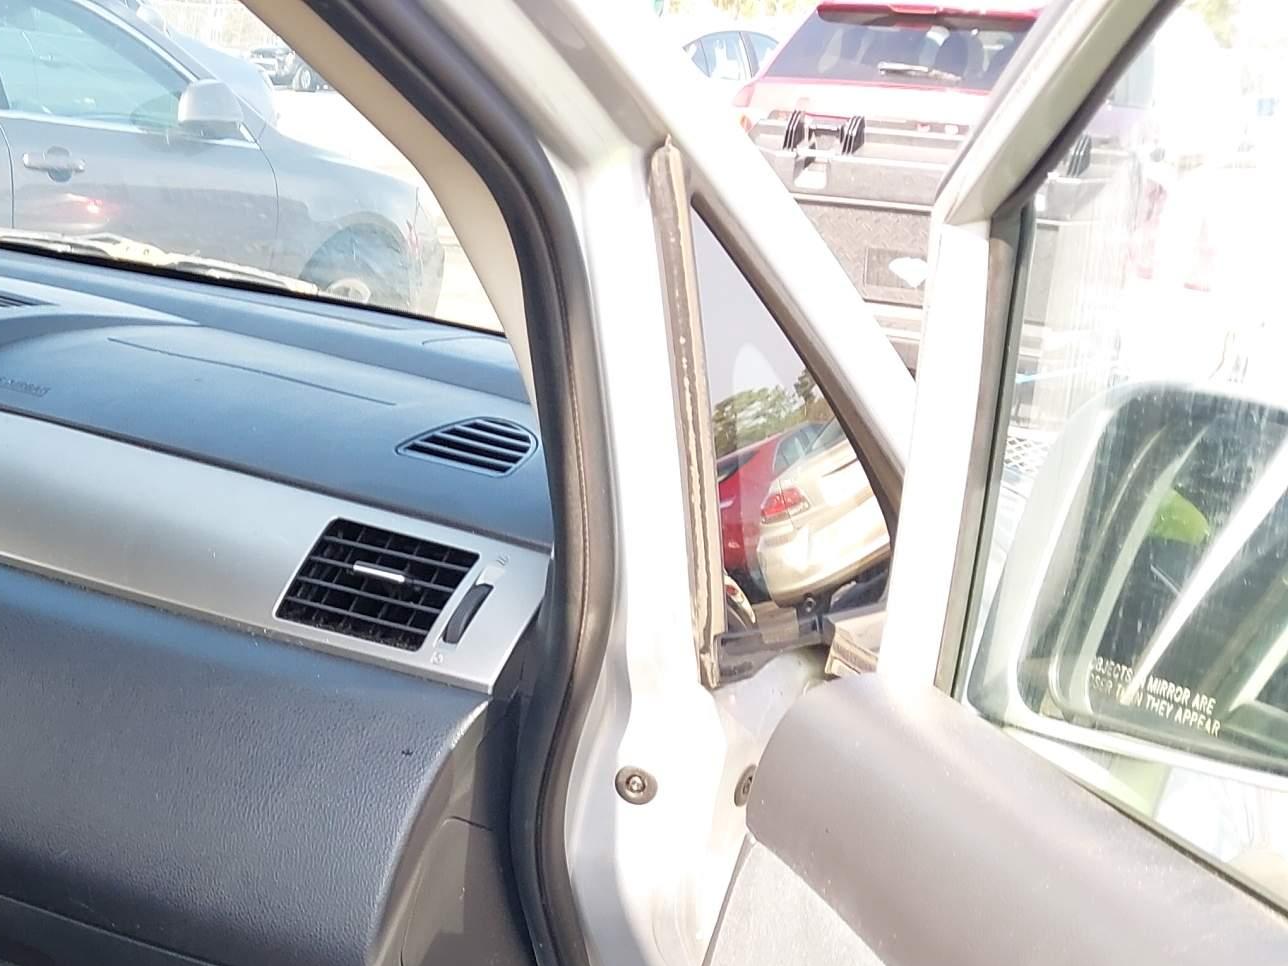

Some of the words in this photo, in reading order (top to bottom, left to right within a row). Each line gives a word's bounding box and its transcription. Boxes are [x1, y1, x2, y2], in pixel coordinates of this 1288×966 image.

[1145, 693, 1174, 719] THEY
[1174, 706, 1221, 737] APPEAR
[1146, 675, 1191, 706] MIRROR
[1192, 692, 1217, 716] ARE
